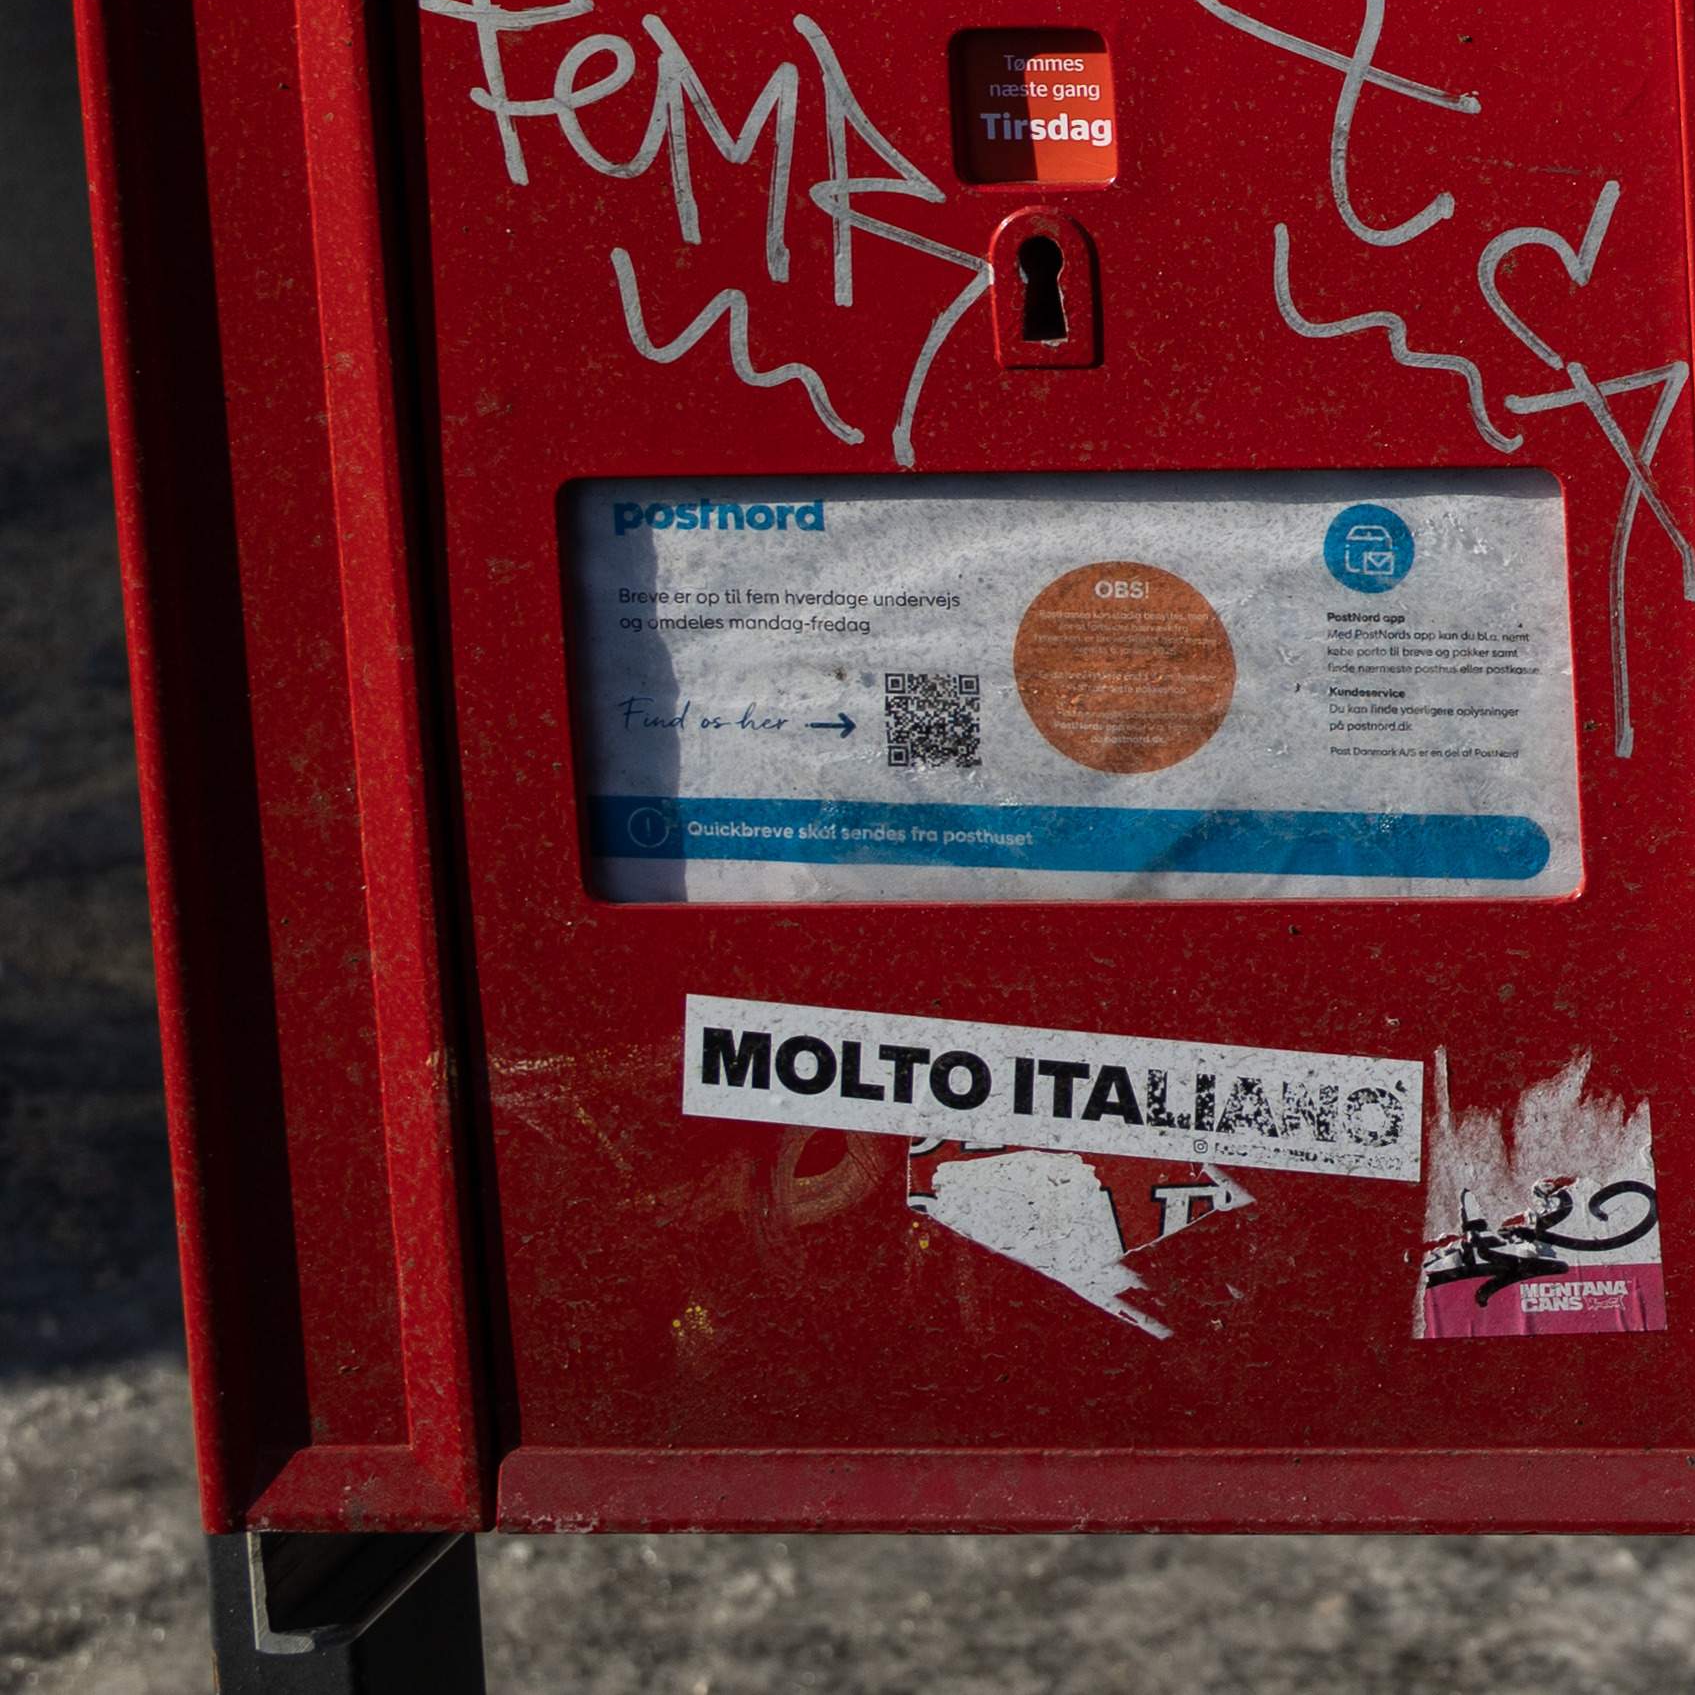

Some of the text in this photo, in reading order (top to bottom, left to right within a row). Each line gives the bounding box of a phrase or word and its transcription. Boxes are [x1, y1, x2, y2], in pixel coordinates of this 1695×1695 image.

[1003, 55, 1084, 72] Tømmes
[989, 81, 1100, 101] næste gang
[980, 112, 1112, 146] Tirsdag
[613, 498, 826, 536] postnord
[1094, 580, 1150, 599] OBS!
[618, 588, 961, 610] Breve er op til fem hverdage undervejs
[619, 614, 871, 634] og omdeles mandag-fredag
[1327, 611, 1405, 624] PostNord app
[1327, 629, 1530, 642] Med PostNords app kan du nemt
[1357, 647, 1518, 659] porto til breve og pakker samt
[1327, 663, 1355, 673] finde
[1414, 664, 1457, 675] posthus
[1460, 665, 1483, 674] eller
[1329, 687, 1406, 698] Kundeservice
[617, 696, 790, 731] Find os her
[1329, 704, 1345, 714] Du
[1347, 704, 1367, 714] kan
[1370, 704, 1398, 715] finde
[1456, 707, 1519, 718] oplysninger
[1329, 720, 1345, 732] på
[1330, 746, 1350, 756] Post
[1353, 747, 1397, 757] Danmark
[1444, 748, 1460, 758] del
[1462, 749, 1473, 758] af
[1475, 750, 1519, 759] PostNord
[687, 820, 1033, 848] Quickbreve skal sendes fra posthuset
[702, 1026, 1404, 1148] MOLTO ITALIANO
[1519, 1280, 1628, 1298] MONTANA
[1520, 1296, 1584, 1312] CANS
